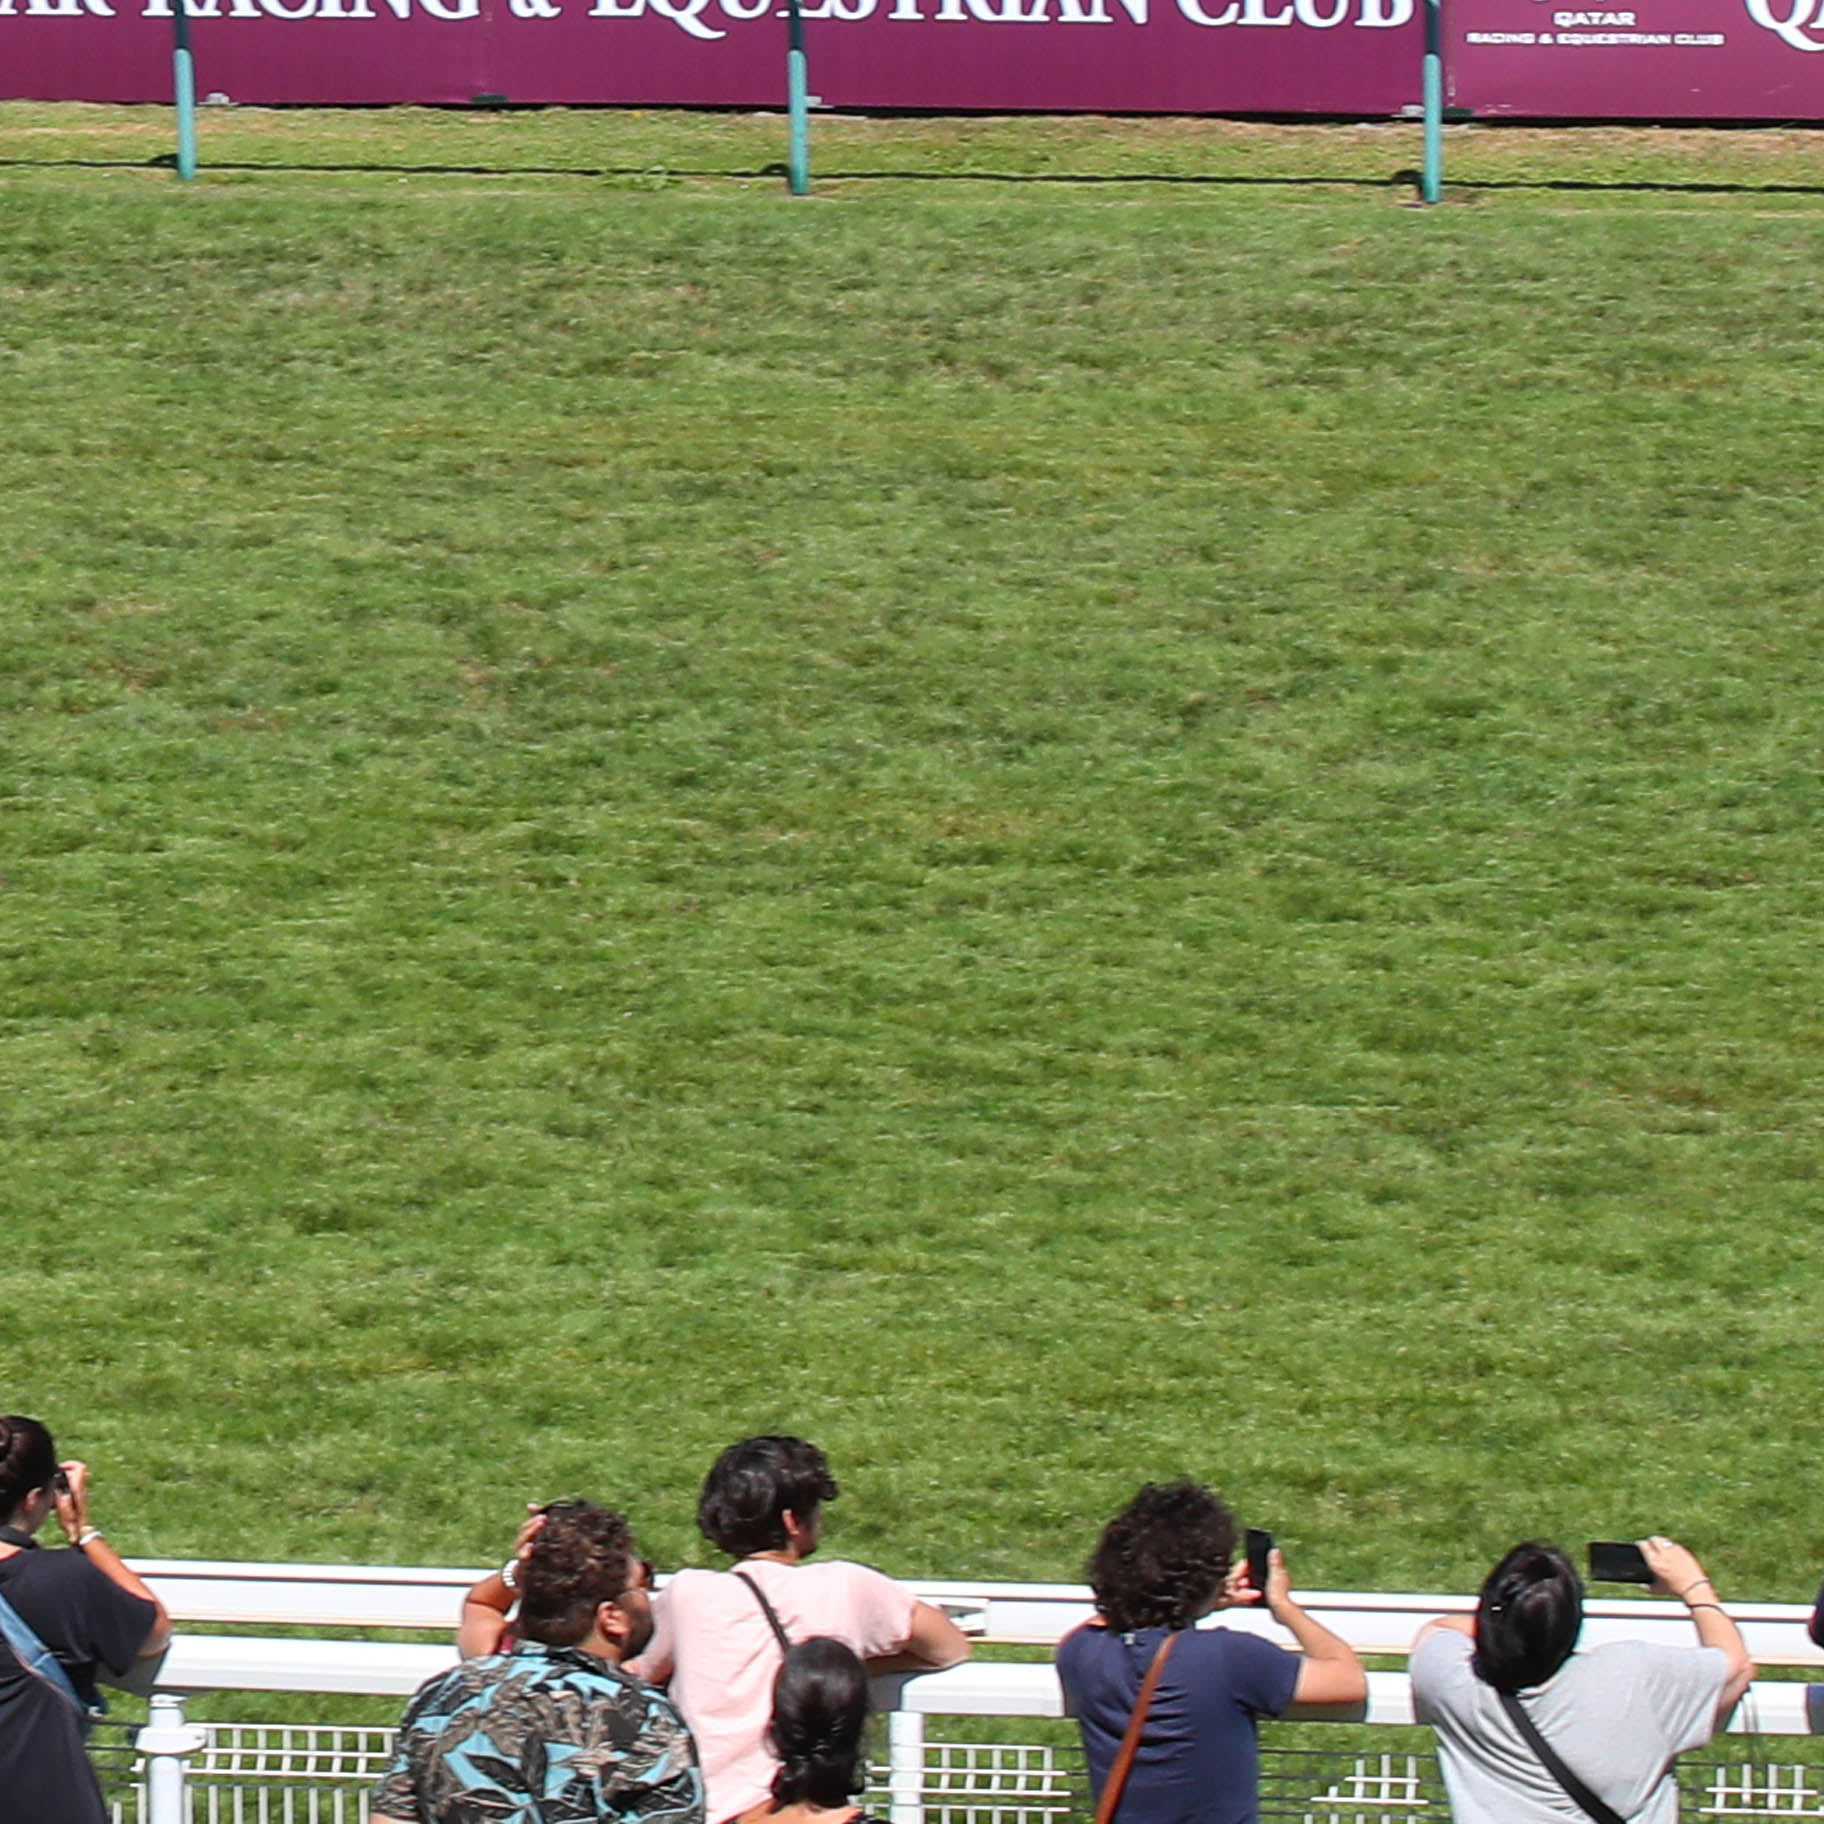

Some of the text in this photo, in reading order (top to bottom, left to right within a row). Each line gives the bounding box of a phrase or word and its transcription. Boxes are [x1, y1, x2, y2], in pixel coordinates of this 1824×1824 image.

[1552, 11, 1637, 27] QATAR
[1466, 32, 1537, 44] RACING
[1556, 33, 1672, 46] EQUESTRIAN
[1674, 33, 1725, 46] CLUB
